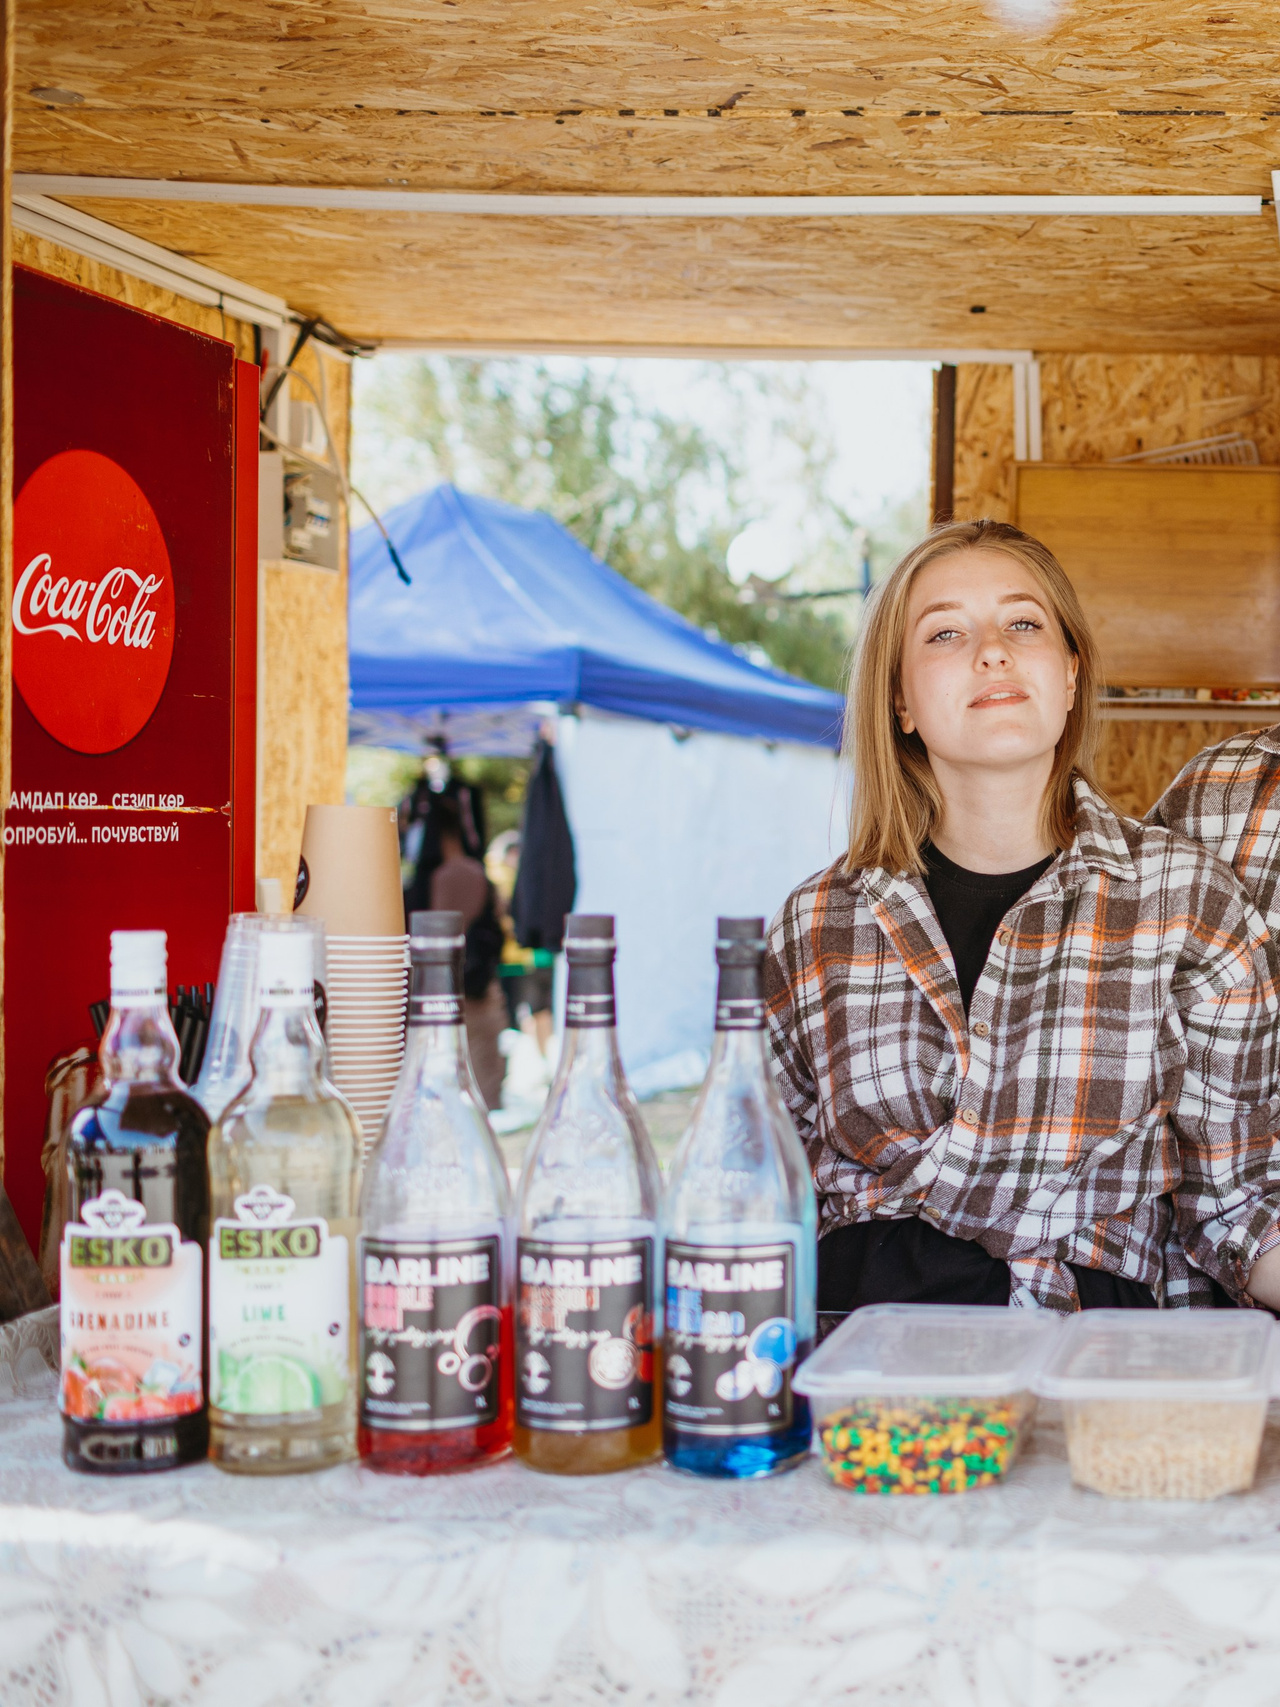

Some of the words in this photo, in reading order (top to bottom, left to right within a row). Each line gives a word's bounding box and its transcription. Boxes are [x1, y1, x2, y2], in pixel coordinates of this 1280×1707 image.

[12, 552, 165, 649] Coca-Cola
[112, 793, 155, 810] СЕЗИП
[159, 794, 185, 810] КӨР
[92, 821, 179, 843] ПОЧУВСТВУЙ
[71, 1236, 171, 1267] ESKO
[220, 1225, 318, 1259] ESKO
[365, 1253, 490, 1287] BARLINE
[521, 1255, 642, 1288] BARLINE
[667, 1258, 784, 1292] BARLINE
[243, 1304, 286, 1322] LIME
